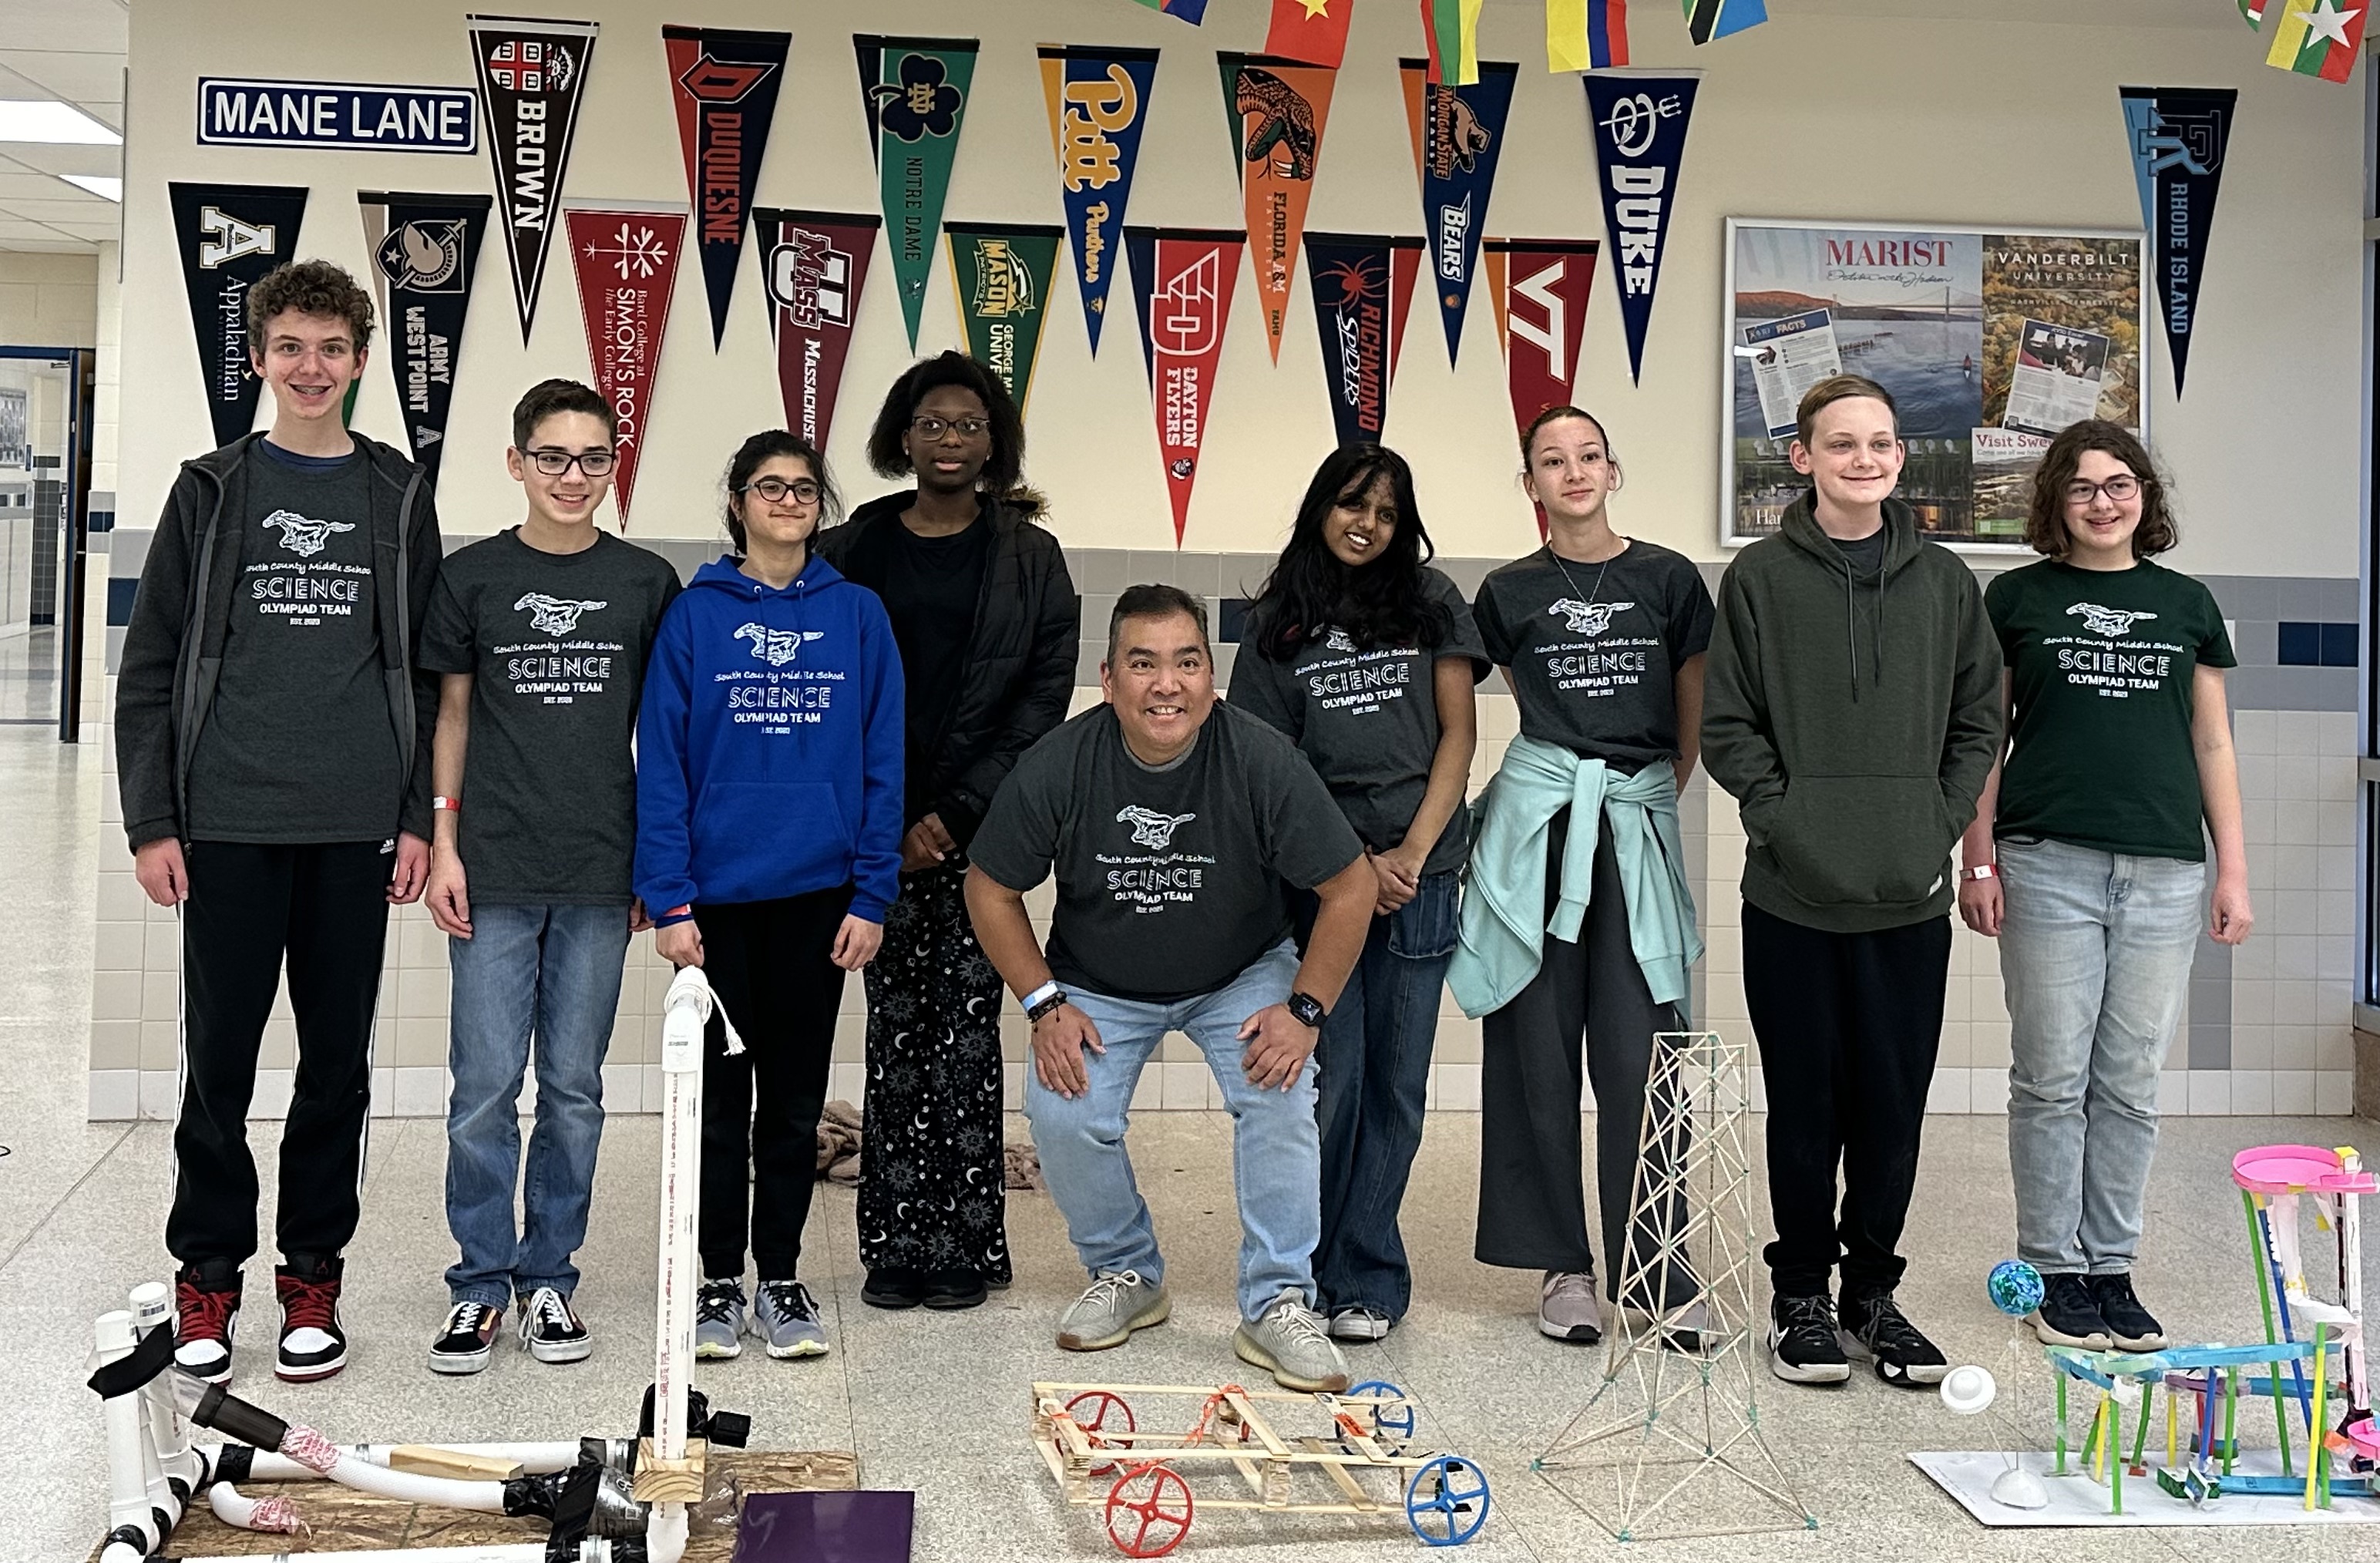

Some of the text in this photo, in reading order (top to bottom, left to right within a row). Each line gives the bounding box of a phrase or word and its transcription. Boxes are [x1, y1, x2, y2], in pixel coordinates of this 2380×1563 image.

[214, 91, 465, 141] MANE LANE
[1064, 63, 1138, 193] Pitt
[1435, 87, 1453, 177] MORGAN STATE
[514, 99, 546, 232] BROWN
[704, 112, 741, 246] DUQUESNE
[904, 156, 923, 262] NOTRE DAME
[1085, 201, 1110, 284] Panthers
[1272, 191, 1288, 294] FLORIDA A&M
[1442, 200, 1467, 282] BEARS
[1611, 165, 1666, 294] DUKE
[1826, 239, 1954, 267] MARIST
[1998, 252, 2129, 266] VANDERBILT
[2170, 183, 2188, 334] RHODE ISLAND
[982, 242, 1009, 315] MASON
[2012, 272, 2115, 282] UNIVERSITY
[637, 289, 648, 318] Bard
[218, 274, 247, 402] Appalachian
[601, 309, 616, 342] Early
[1775, 319, 1807, 334] FACTS
[634, 321, 649, 365] College
[1003, 324, 1014, 375] GEORGE
[1336, 299, 1362, 415] SPIDERS
[406, 306, 429, 414] WEST POINT
[429, 333, 450, 385] ARMY
[600, 345, 616, 392] College
[615, 287, 636, 449] SIMON'S ROCK
[1359, 301, 1381, 433] RICHMOND
[1166, 367, 1182, 447] FLYERS
[1182, 366, 1199, 449] DAYTON
[1975, 434, 2014, 448] Visit
[271, 563, 307, 574] County
[308, 560, 342, 573] Middle
[251, 576, 360, 602] SCIENCE
[260, 603, 351, 615] OLYMPIAD TEAM
[493, 643, 521, 654] South
[523, 641, 560, 654] County
[561, 640, 595, 650] Middle
[1534, 637, 1660, 654] South County Middle School
[2042, 635, 2184, 654] South County Middle School
[508, 656, 612, 680] SCIENCE
[714, 671, 741, 682] South
[815, 671, 845, 681] School
[1294, 647, 1420, 677] South County Middle School
[1547, 652, 1646, 678] SCIENCE
[2058, 648, 2171, 677] SCIENCE
[515, 682, 603, 694] OLYMPIAD TEAM
[1309, 662, 1410, 697] SCIENCE
[1558, 674, 1639, 690] OLYMPIAD TEAM
[2068, 673, 2160, 691] OLYMPIAD TEAM
[728, 687, 832, 708] SCIENCE
[1322, 687, 1403, 709] OLYMPIAD TEAM
[734, 712, 822, 723] OLYMPIAD TEAM
[1095, 853, 1122, 864] South
[1185, 854, 1217, 864] School
[1106, 867, 1203, 892] SCIENCE
[1114, 889, 1194, 904] OLYMPIAD TEAM
